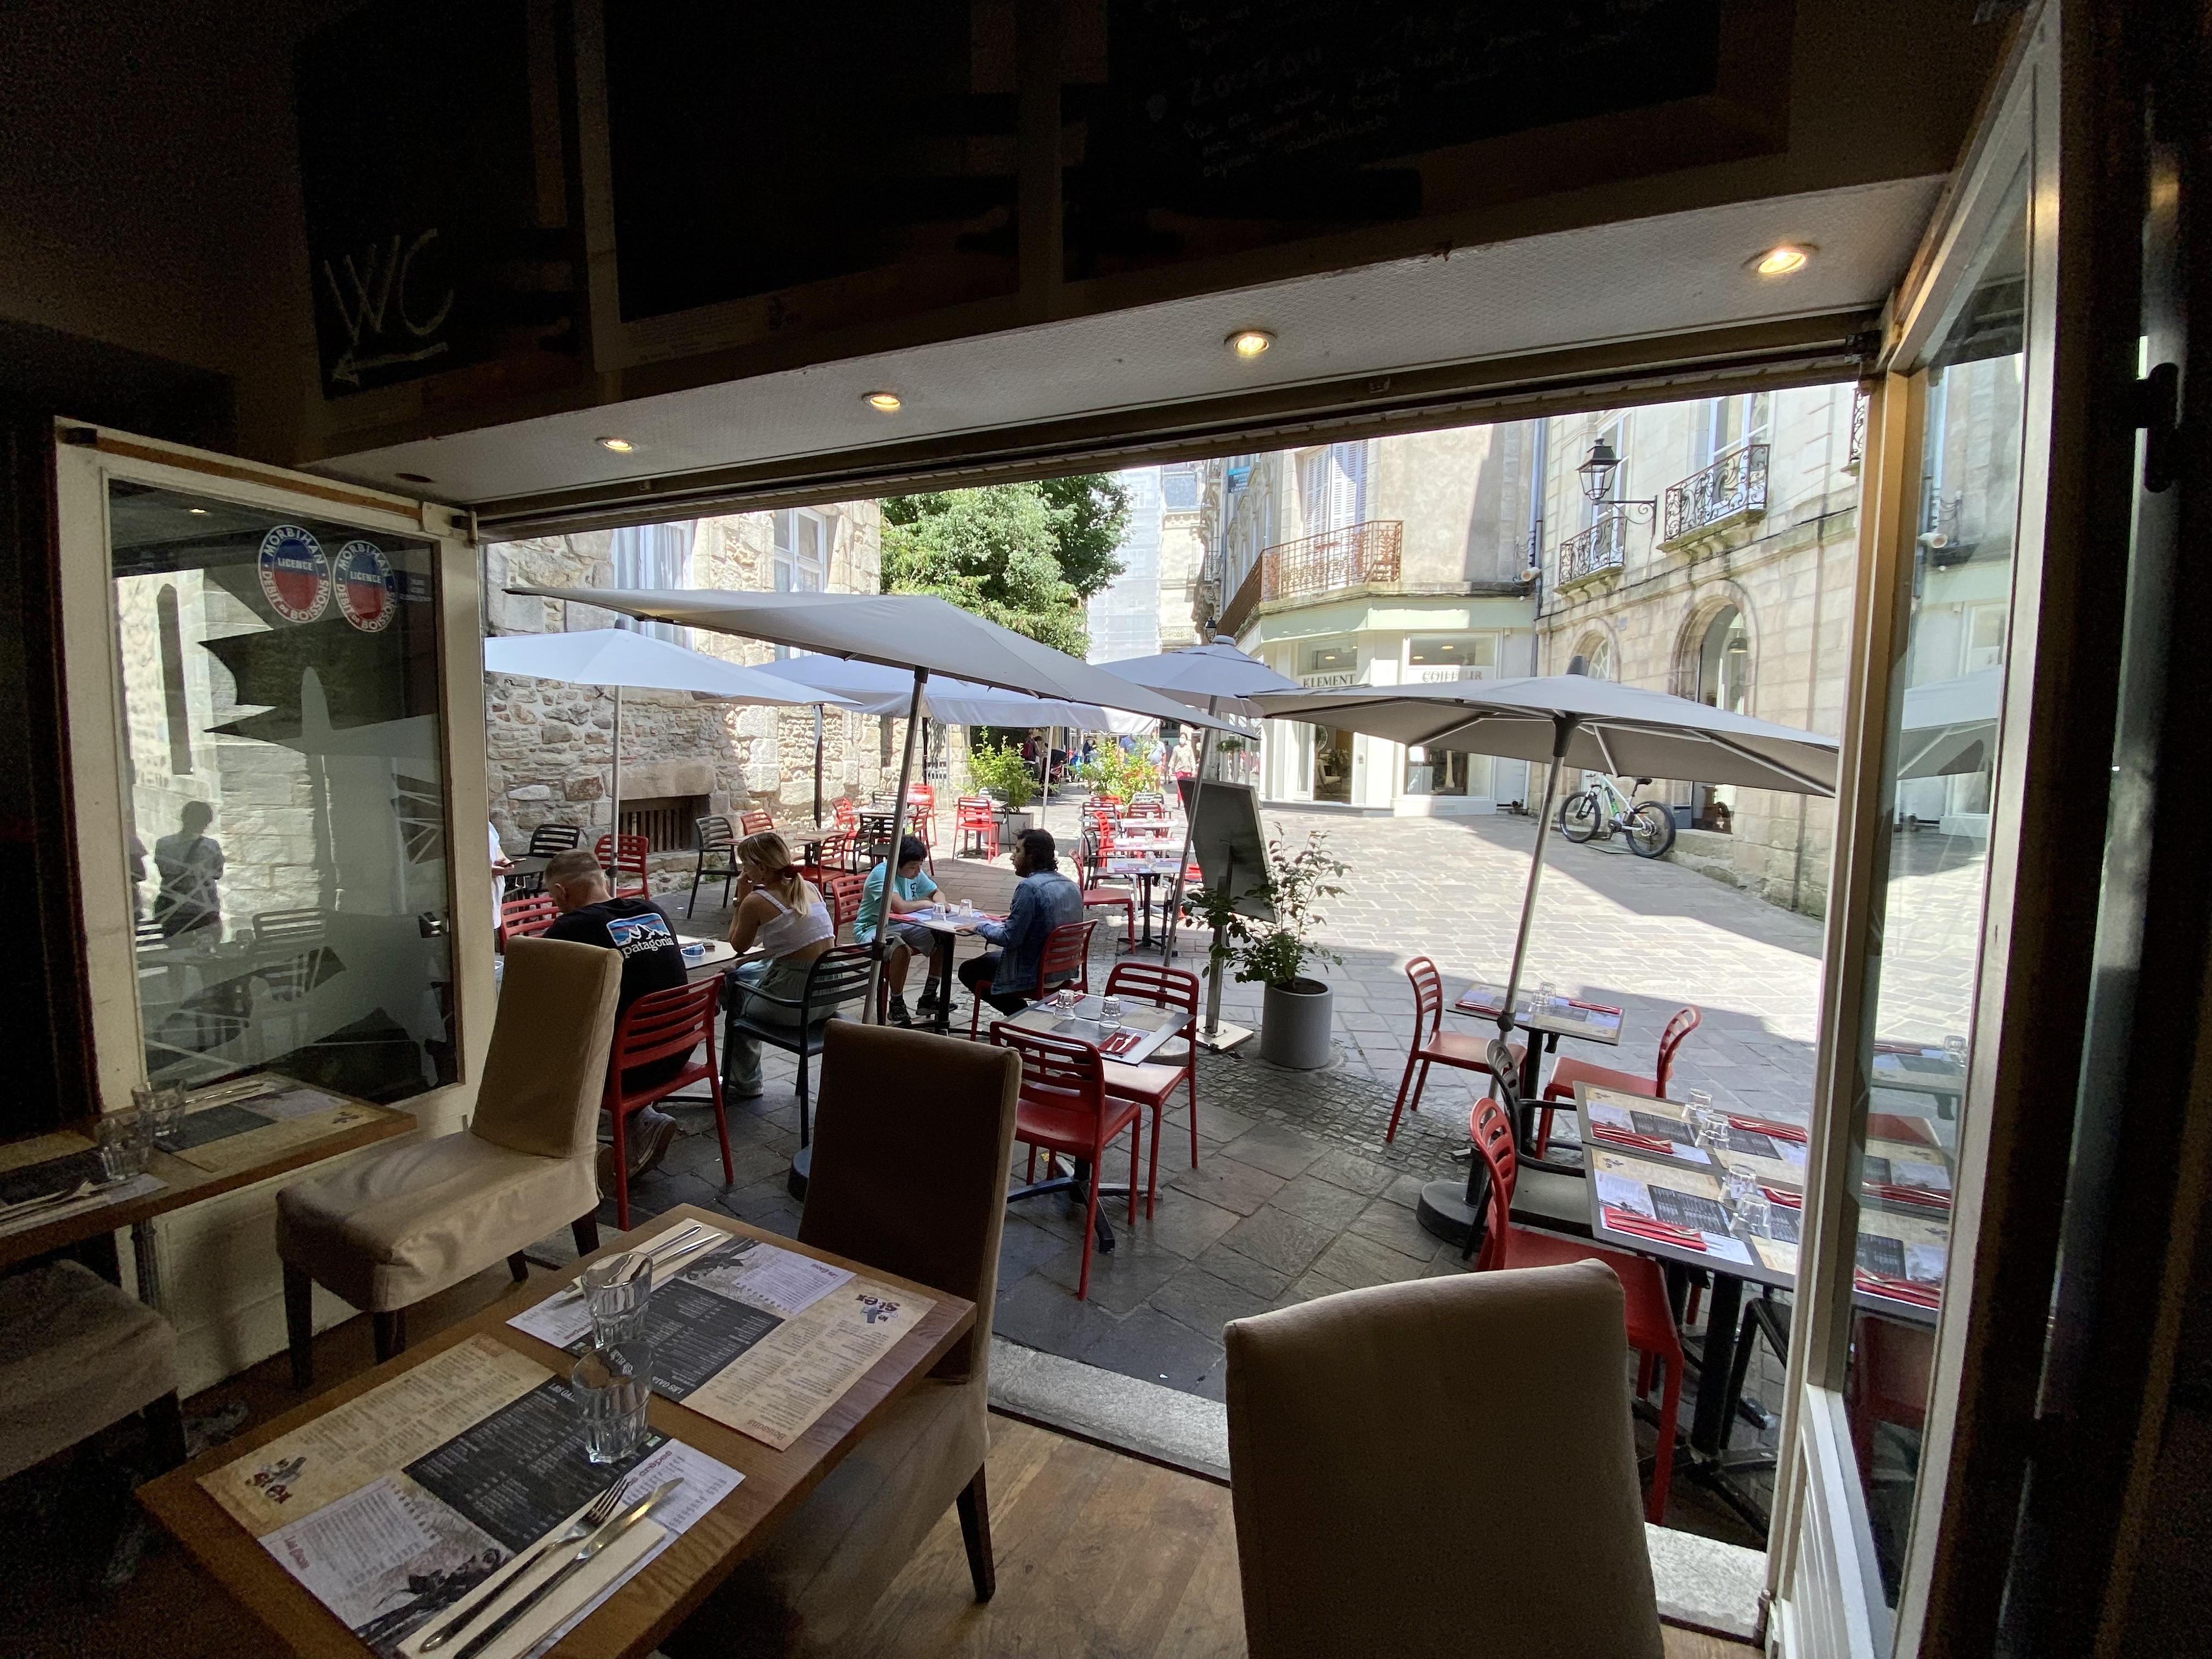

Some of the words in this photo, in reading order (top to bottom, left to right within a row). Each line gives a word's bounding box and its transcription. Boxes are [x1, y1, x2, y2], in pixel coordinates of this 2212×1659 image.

[323, 227, 454, 347] WC
[264, 528, 325, 565] MORBIHAN
[338, 543, 391, 577] MORBIHAN
[276, 557, 314, 571] LICENCE
[349, 571, 382, 584] LICENCE
[262, 571, 283, 605] DEBIT
[290, 579, 329, 620] BOISSONS
[361, 591, 396, 629] BOISSONS
[1303, 674, 1355, 688] KLEMENT
[620, 935, 675, 960] patagonia
